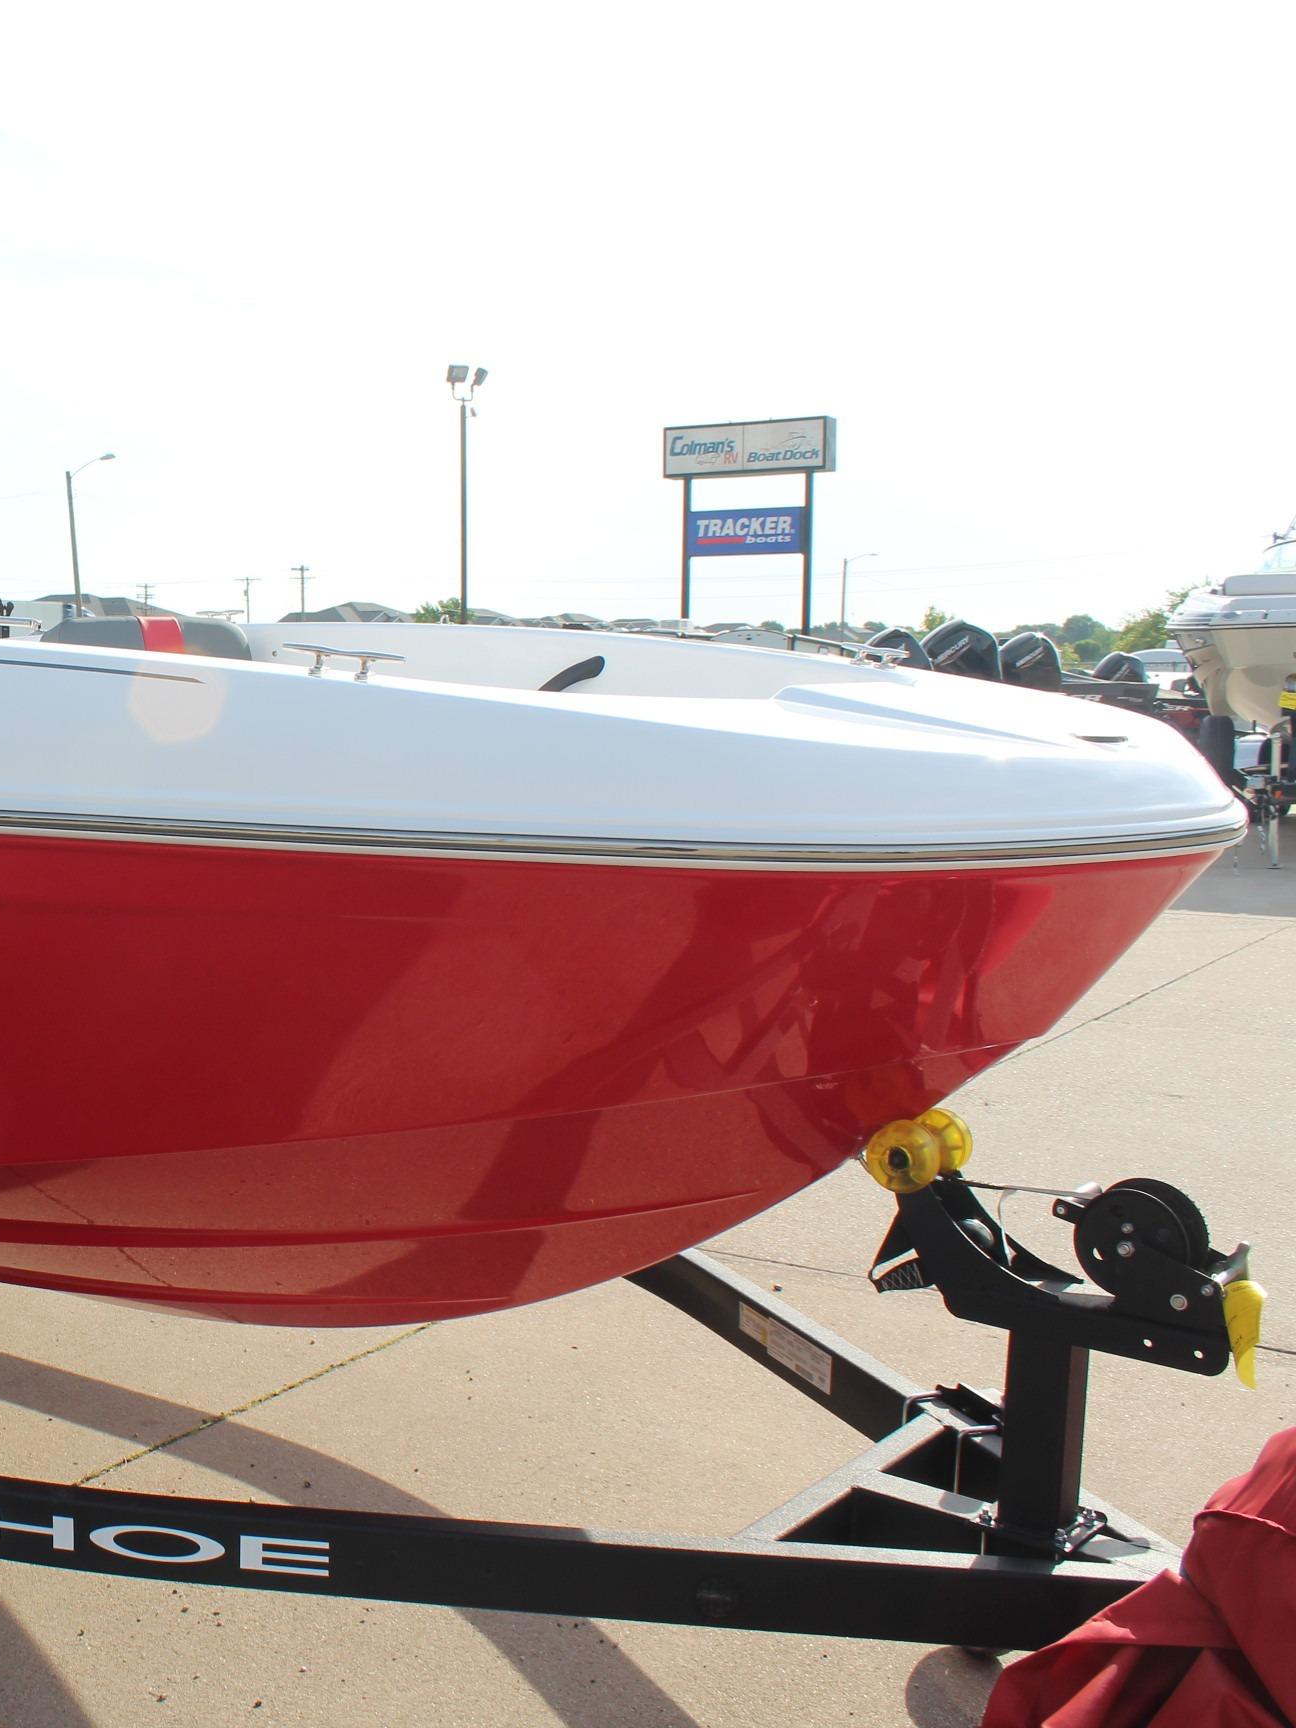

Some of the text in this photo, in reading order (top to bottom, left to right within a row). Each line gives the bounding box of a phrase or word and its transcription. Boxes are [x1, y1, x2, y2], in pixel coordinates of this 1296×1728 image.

[670, 436, 735, 457] Colman's
[724, 452, 738, 464] RV
[747, 448, 819, 463] Boat Dock
[696, 516, 792, 537] TRACKER
[745, 535, 792, 544] boats
